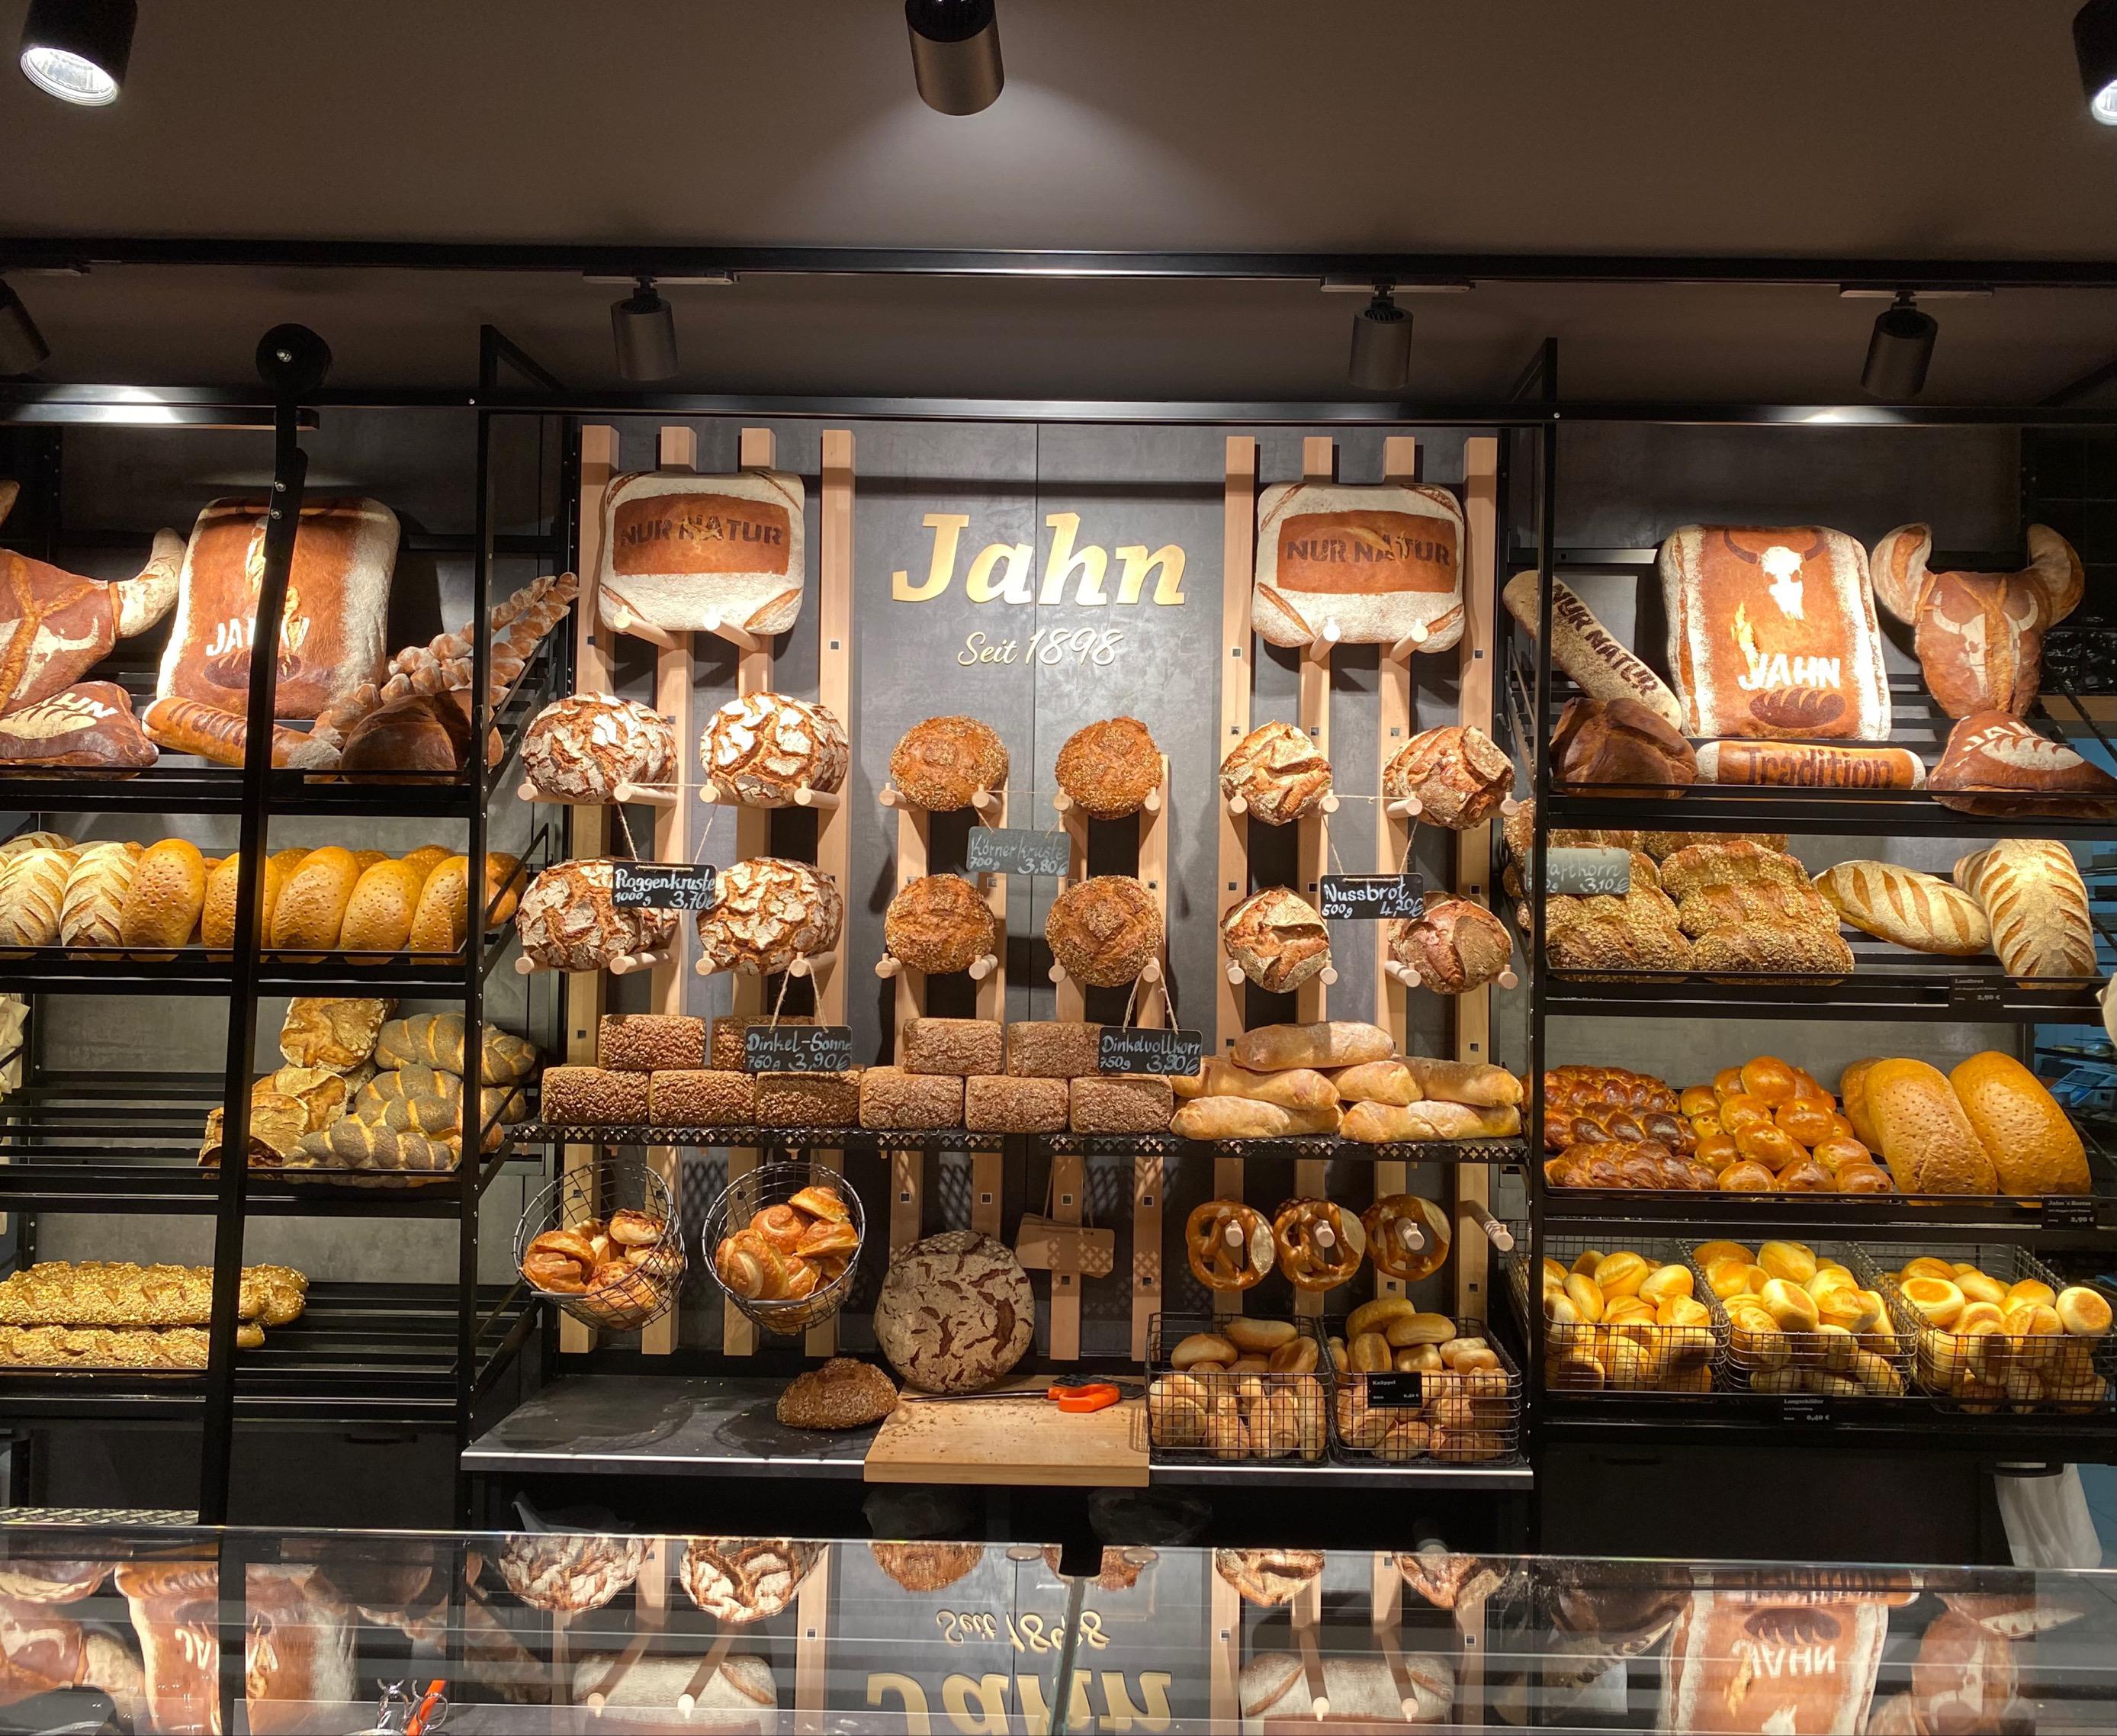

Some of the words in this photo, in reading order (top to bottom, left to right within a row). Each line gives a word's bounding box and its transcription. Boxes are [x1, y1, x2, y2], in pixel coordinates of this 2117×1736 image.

[621, 519, 673, 547] NUR
[892, 512, 1187, 606] Jahn
[1287, 538, 1347, 563] NUR
[1553, 583, 1594, 632] NUR
[957, 631, 1018, 666] Seit
[1025, 627, 1124, 666] 1898
[1737, 653, 1841, 691] JAHN
[1741, 746, 1894, 789] Tradition
[615, 868, 715, 892] Roggenkruste
[1323, 874, 1409, 902] Nussbrot
[614, 891, 652, 907] 1000g
[1321, 903, 1353, 919] 500g
[1380, 897, 1425, 918] 4,20€
[1099, 1056, 1132, 1070] 750g
